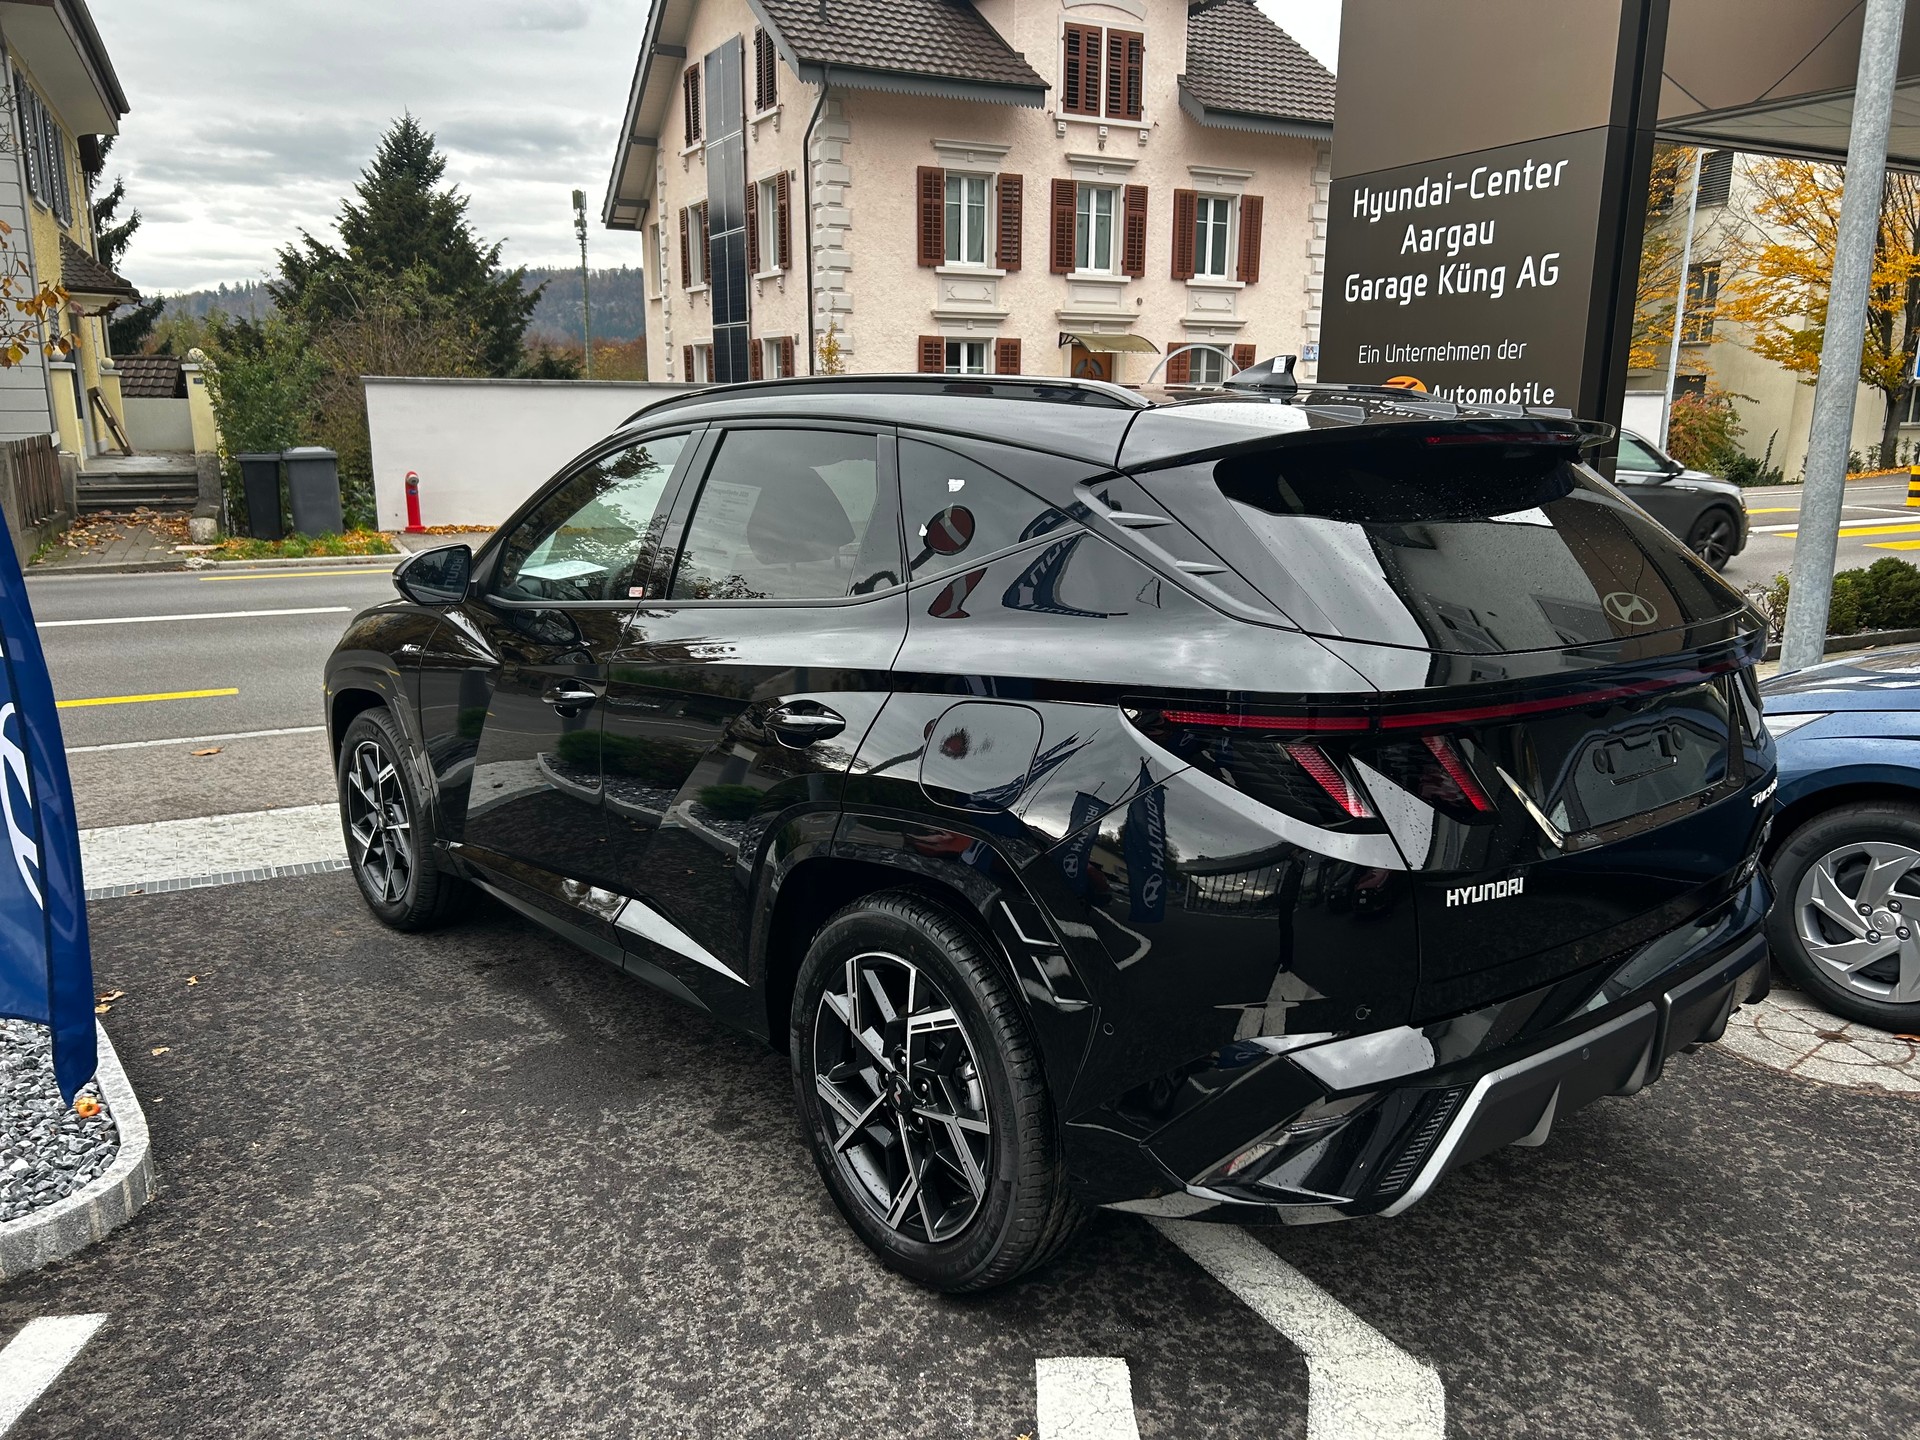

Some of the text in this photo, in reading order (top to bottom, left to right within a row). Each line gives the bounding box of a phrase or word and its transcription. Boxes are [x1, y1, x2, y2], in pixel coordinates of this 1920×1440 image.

[1352, 158, 1569, 223] Hyundai-Center
[1400, 220, 1495, 257] Aargau
[1345, 252, 1561, 306] Garage Küng AG
[1358, 338, 1528, 364] Ein Unternehmen der
[1432, 382, 1556, 407] Automobile
[1446, 876, 1524, 908] HYUNDAI
